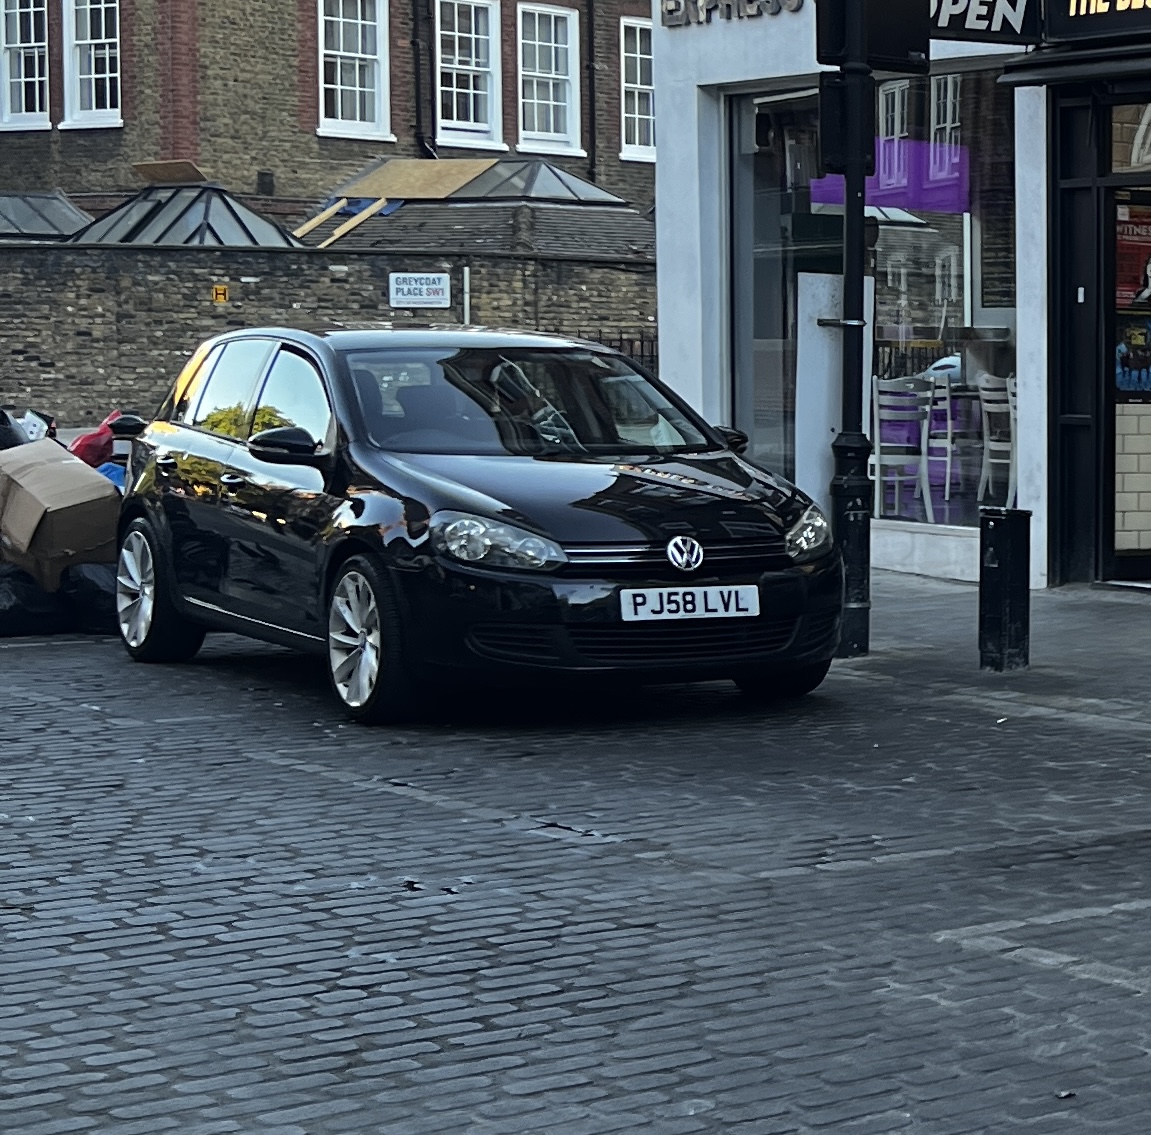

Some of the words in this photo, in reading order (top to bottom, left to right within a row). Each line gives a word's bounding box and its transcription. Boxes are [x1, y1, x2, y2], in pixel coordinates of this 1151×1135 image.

[395, 276, 442, 286] GREYCOAT
[214, 287, 227, 301] H
[395, 287, 423, 297] PLACE
[426, 287, 445, 297] SW1
[632, 591, 697, 616] PJ58
[703, 590, 749, 613] LVL
